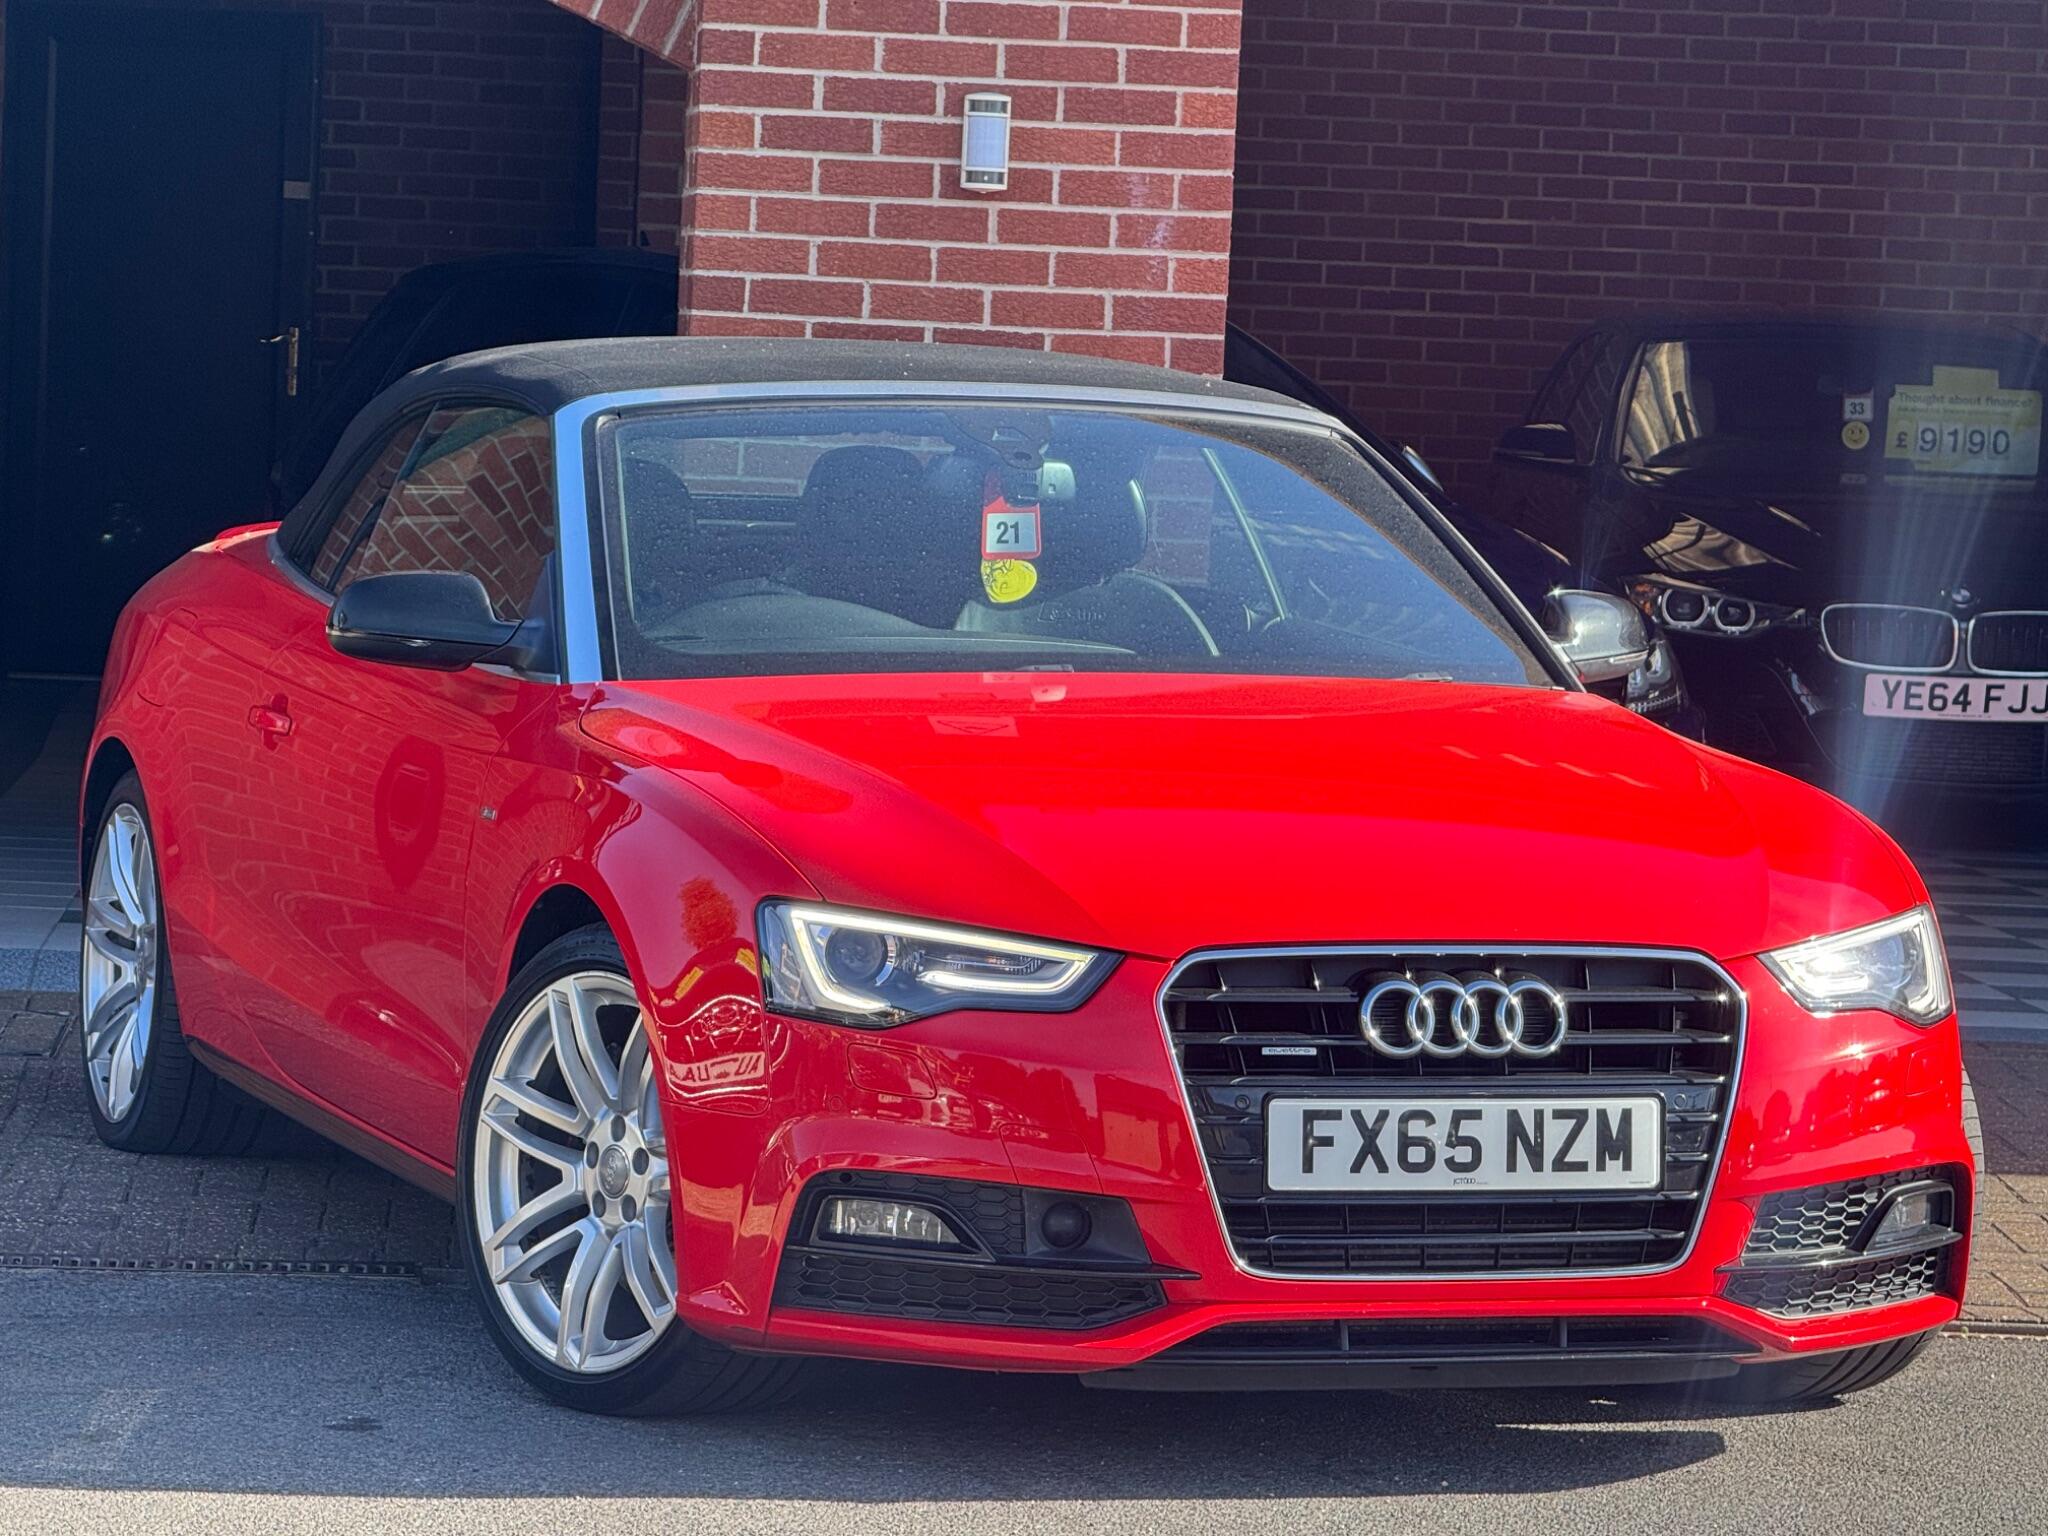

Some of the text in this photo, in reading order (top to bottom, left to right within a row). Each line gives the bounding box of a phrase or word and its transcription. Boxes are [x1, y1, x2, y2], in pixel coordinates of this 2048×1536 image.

[1849, 402, 1865, 415] 33
[1948, 395, 1982, 407] about
[996, 521, 1020, 544] 21
[1882, 679, 2048, 714] YE64 FJJ
[1301, 1107, 1633, 1174] FX65 NZM
